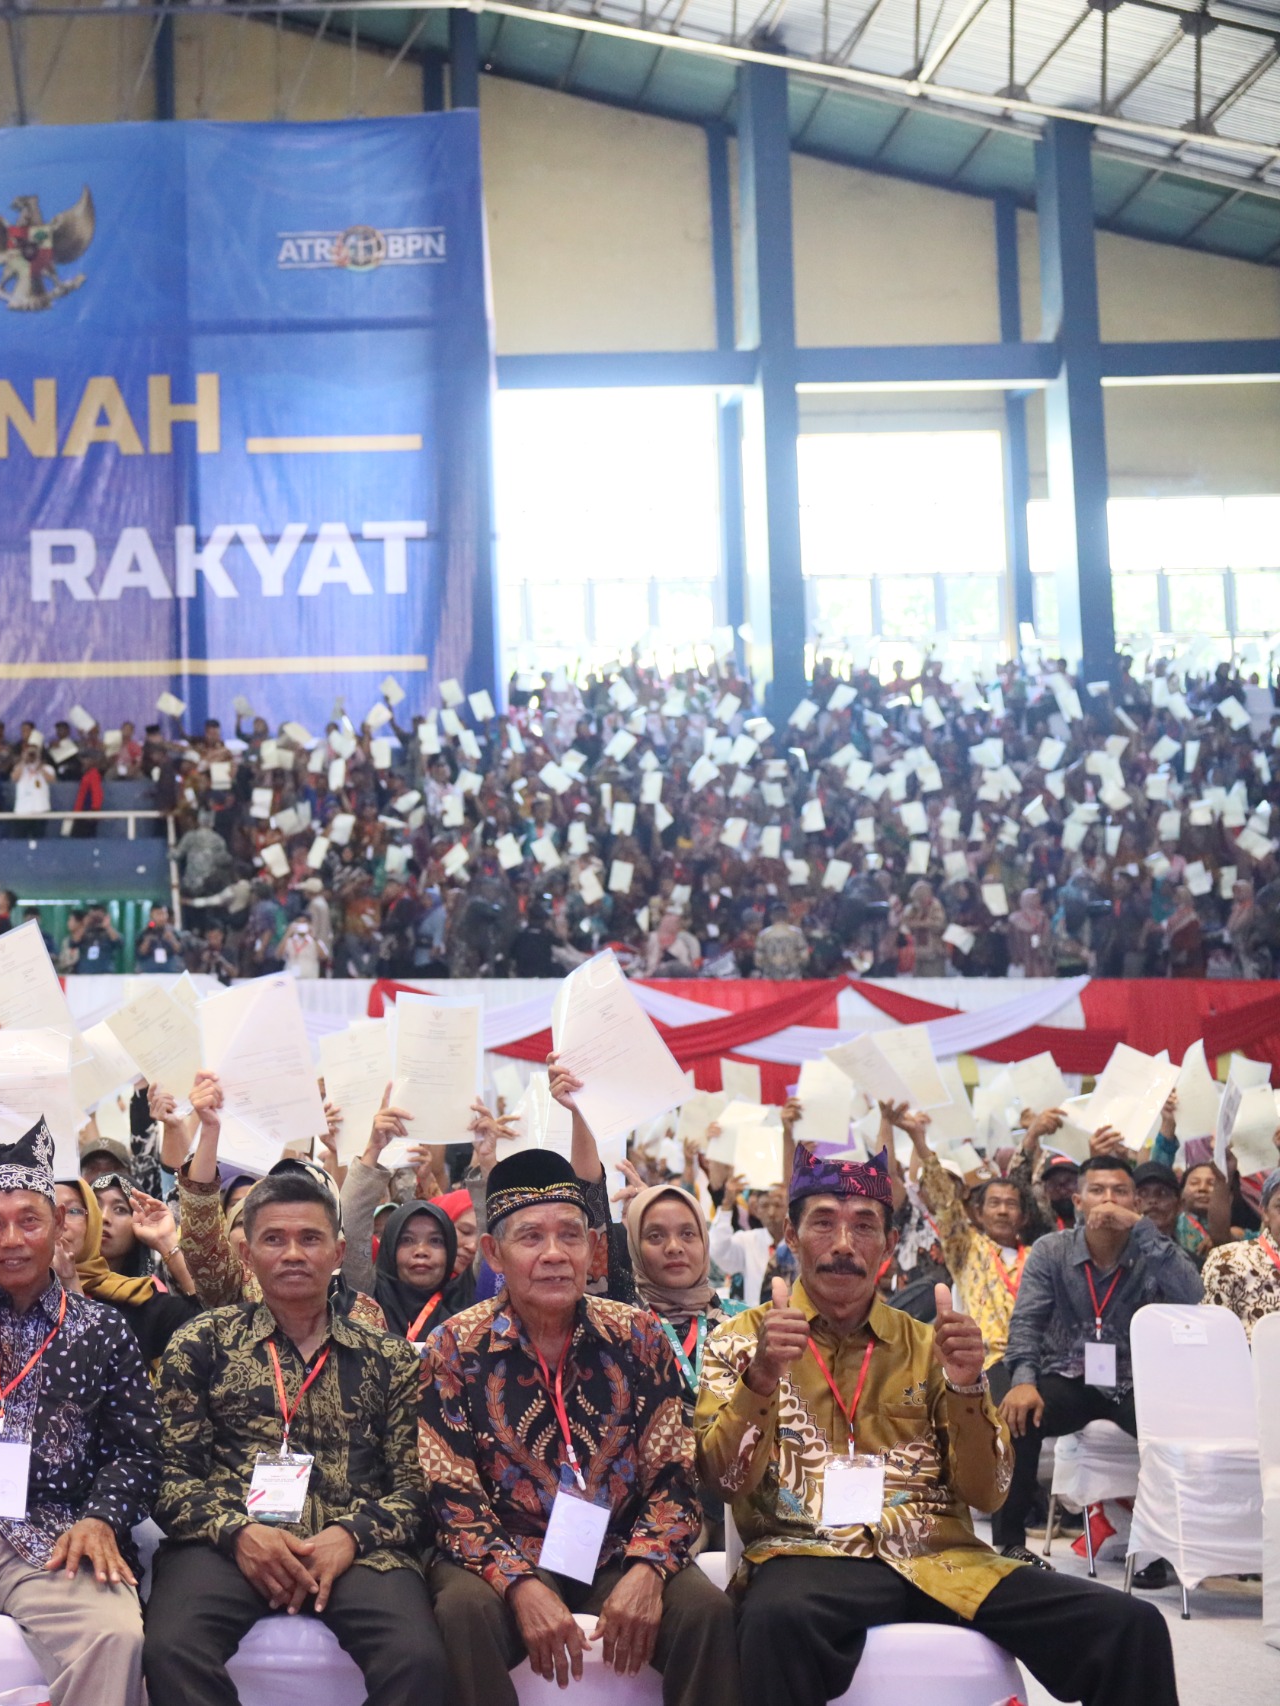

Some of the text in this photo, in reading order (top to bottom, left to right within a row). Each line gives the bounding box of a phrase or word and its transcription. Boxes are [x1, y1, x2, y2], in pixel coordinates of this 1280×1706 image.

[277, 233, 446, 262] ATR BPN
[30, 520, 428, 602] RAKYAT
